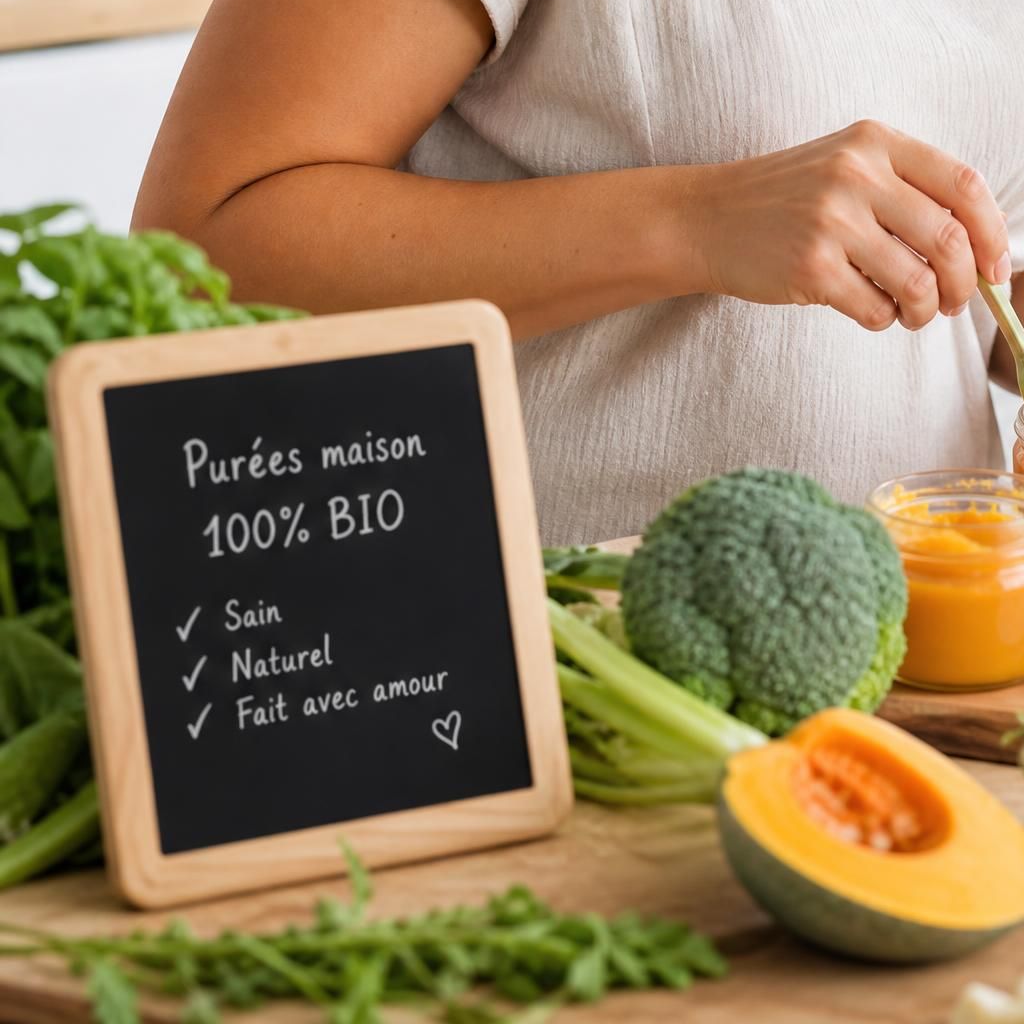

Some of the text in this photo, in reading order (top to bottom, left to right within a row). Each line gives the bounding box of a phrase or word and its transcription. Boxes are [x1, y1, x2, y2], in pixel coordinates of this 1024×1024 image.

[183, 431, 426, 487] Purées maison
[204, 489, 404, 557] 100% BIO
[225, 599, 282, 631] Sain
[232, 633, 333, 682] Naturel
[237, 671, 448, 729] Fait avec amour
